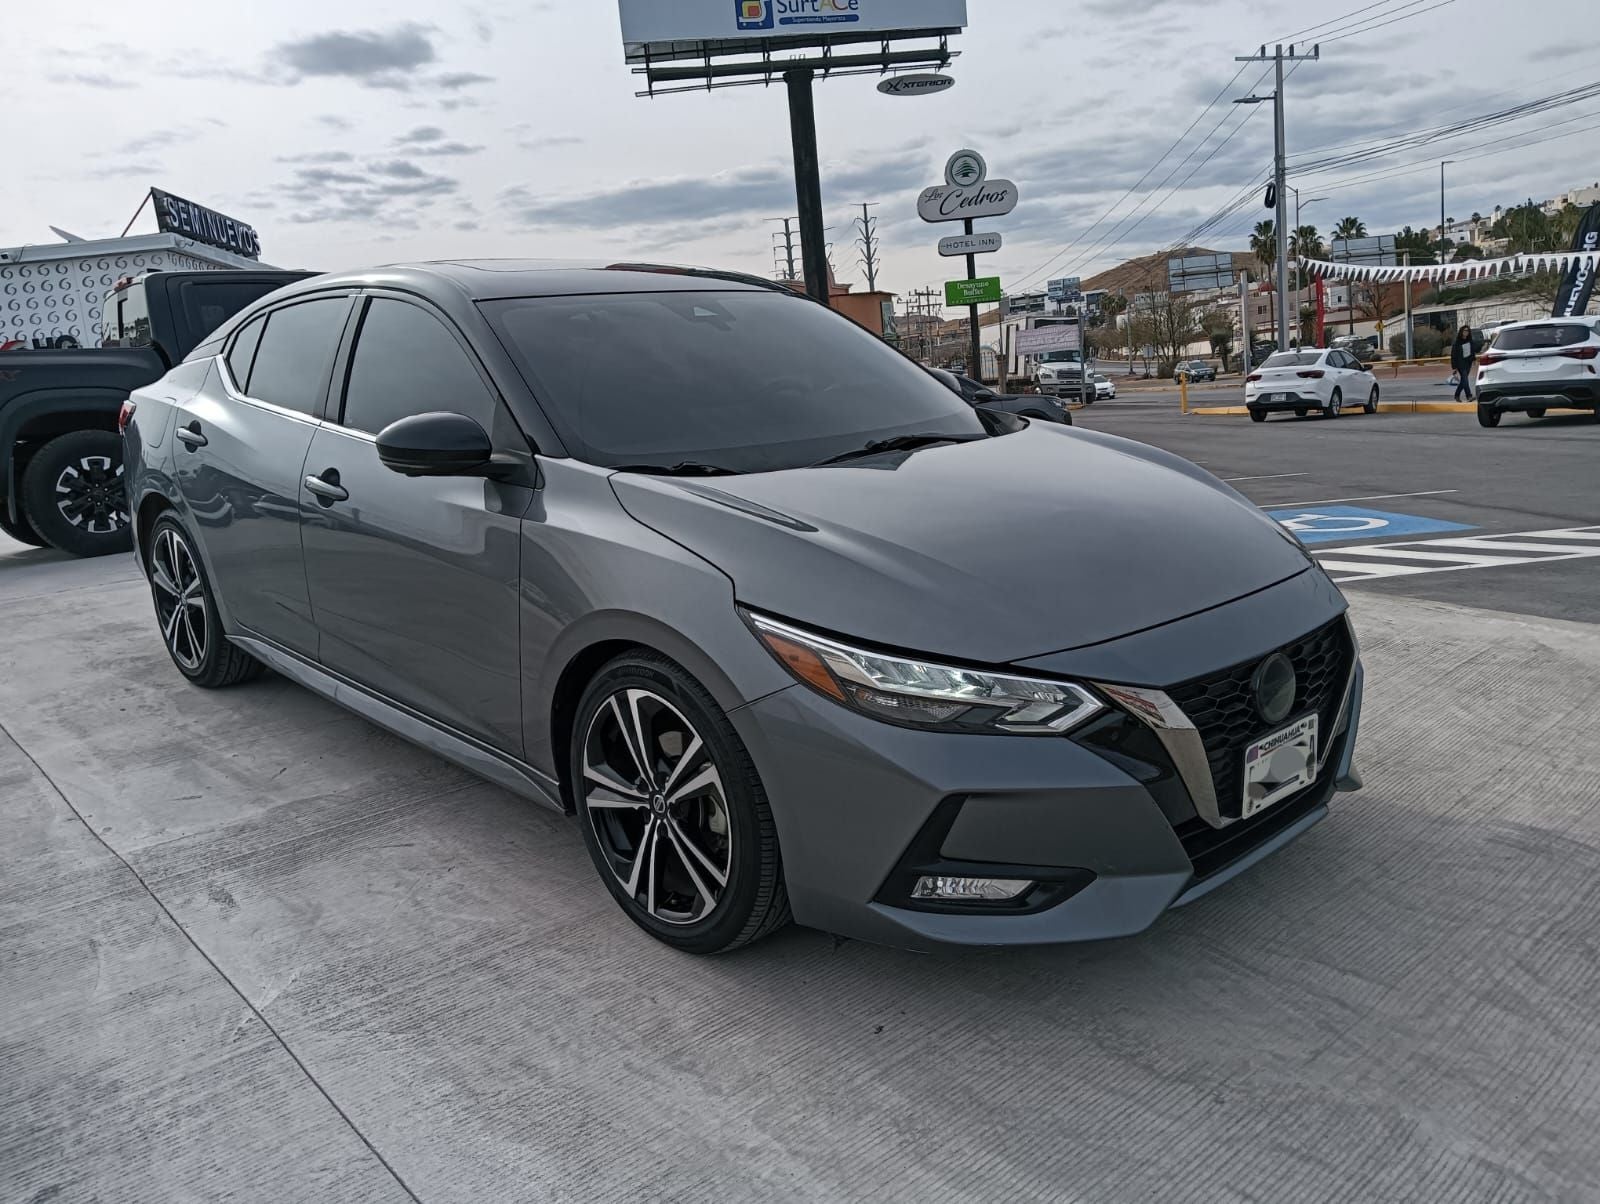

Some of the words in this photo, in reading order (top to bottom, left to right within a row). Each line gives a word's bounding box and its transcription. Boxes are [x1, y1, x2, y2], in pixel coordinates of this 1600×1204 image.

[940, 186, 1008, 215] Cedros
[165, 197, 261, 256] SEMINUEVOS
[946, 240, 976, 249] HOTEL
[979, 239, 995, 247] INN
